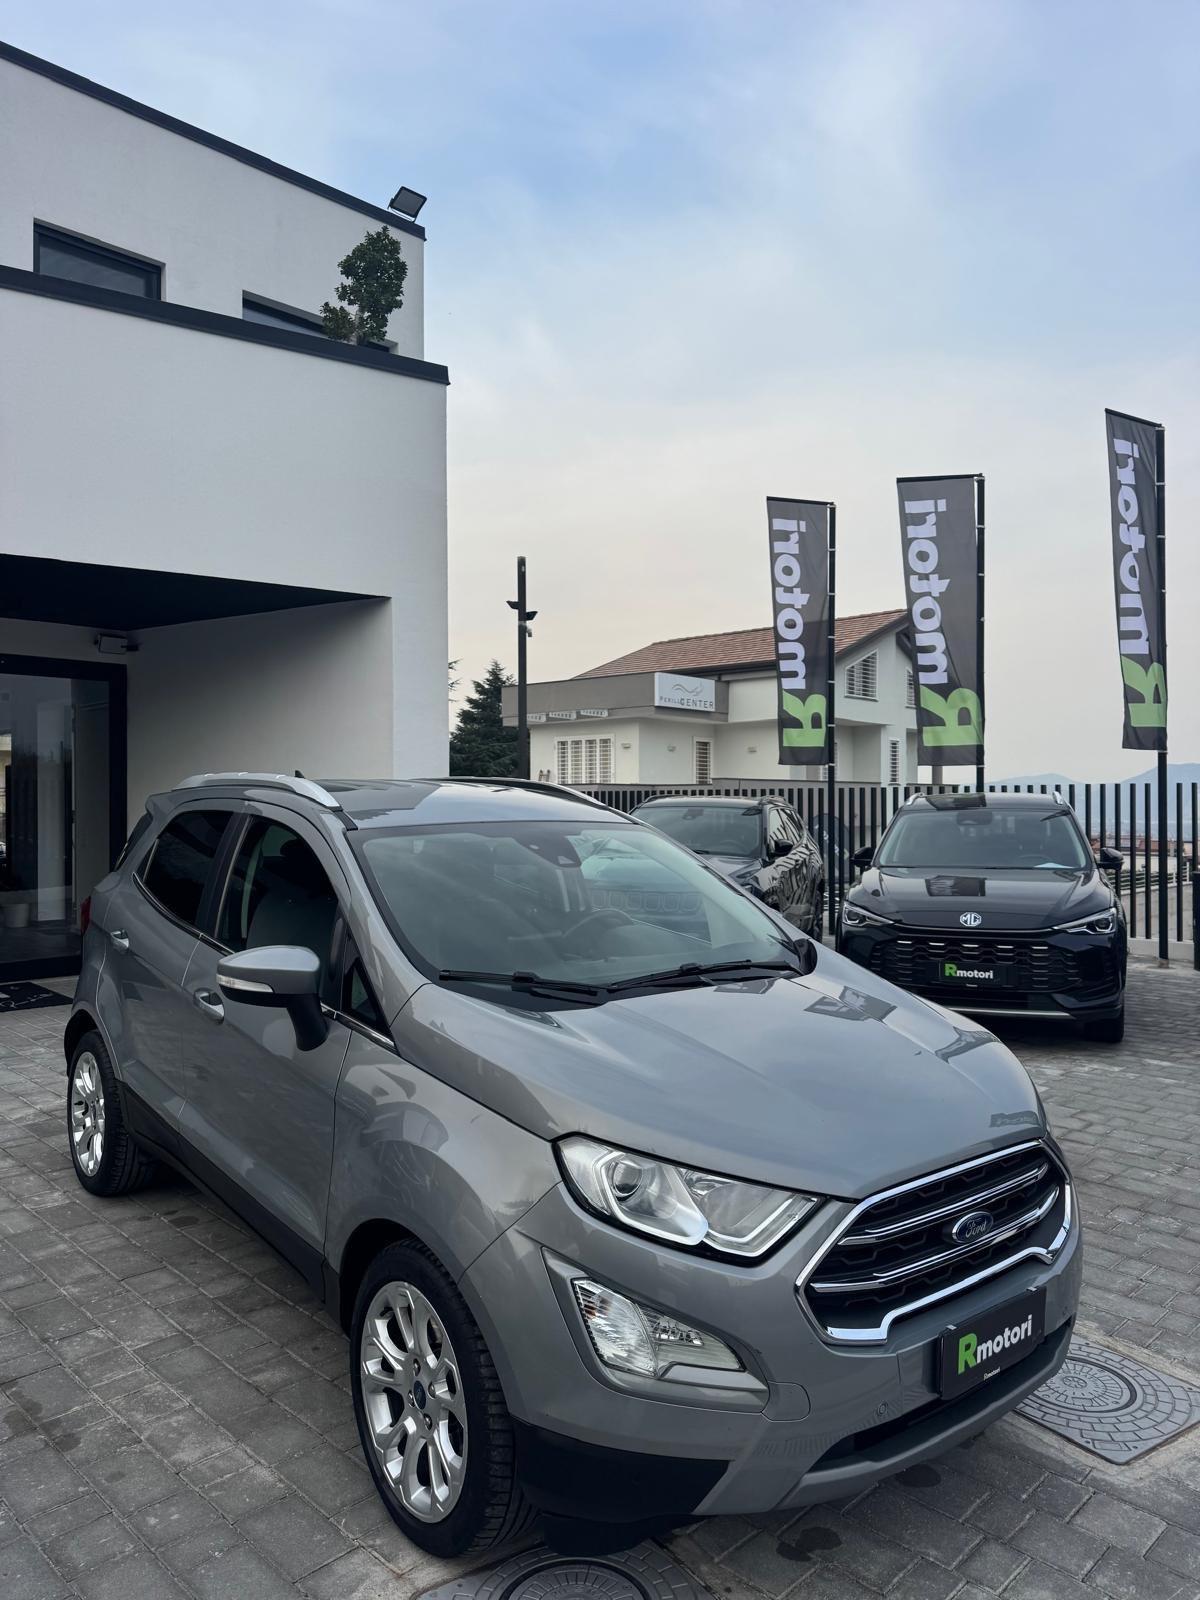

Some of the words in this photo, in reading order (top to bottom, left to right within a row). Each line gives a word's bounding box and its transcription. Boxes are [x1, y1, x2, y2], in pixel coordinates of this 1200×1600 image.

[961, 913, 981, 926] MG
[944, 963, 993, 979] Rmotori
[965, 1217, 987, 1238] Ford
[958, 1314, 1033, 1375] Rmotori
